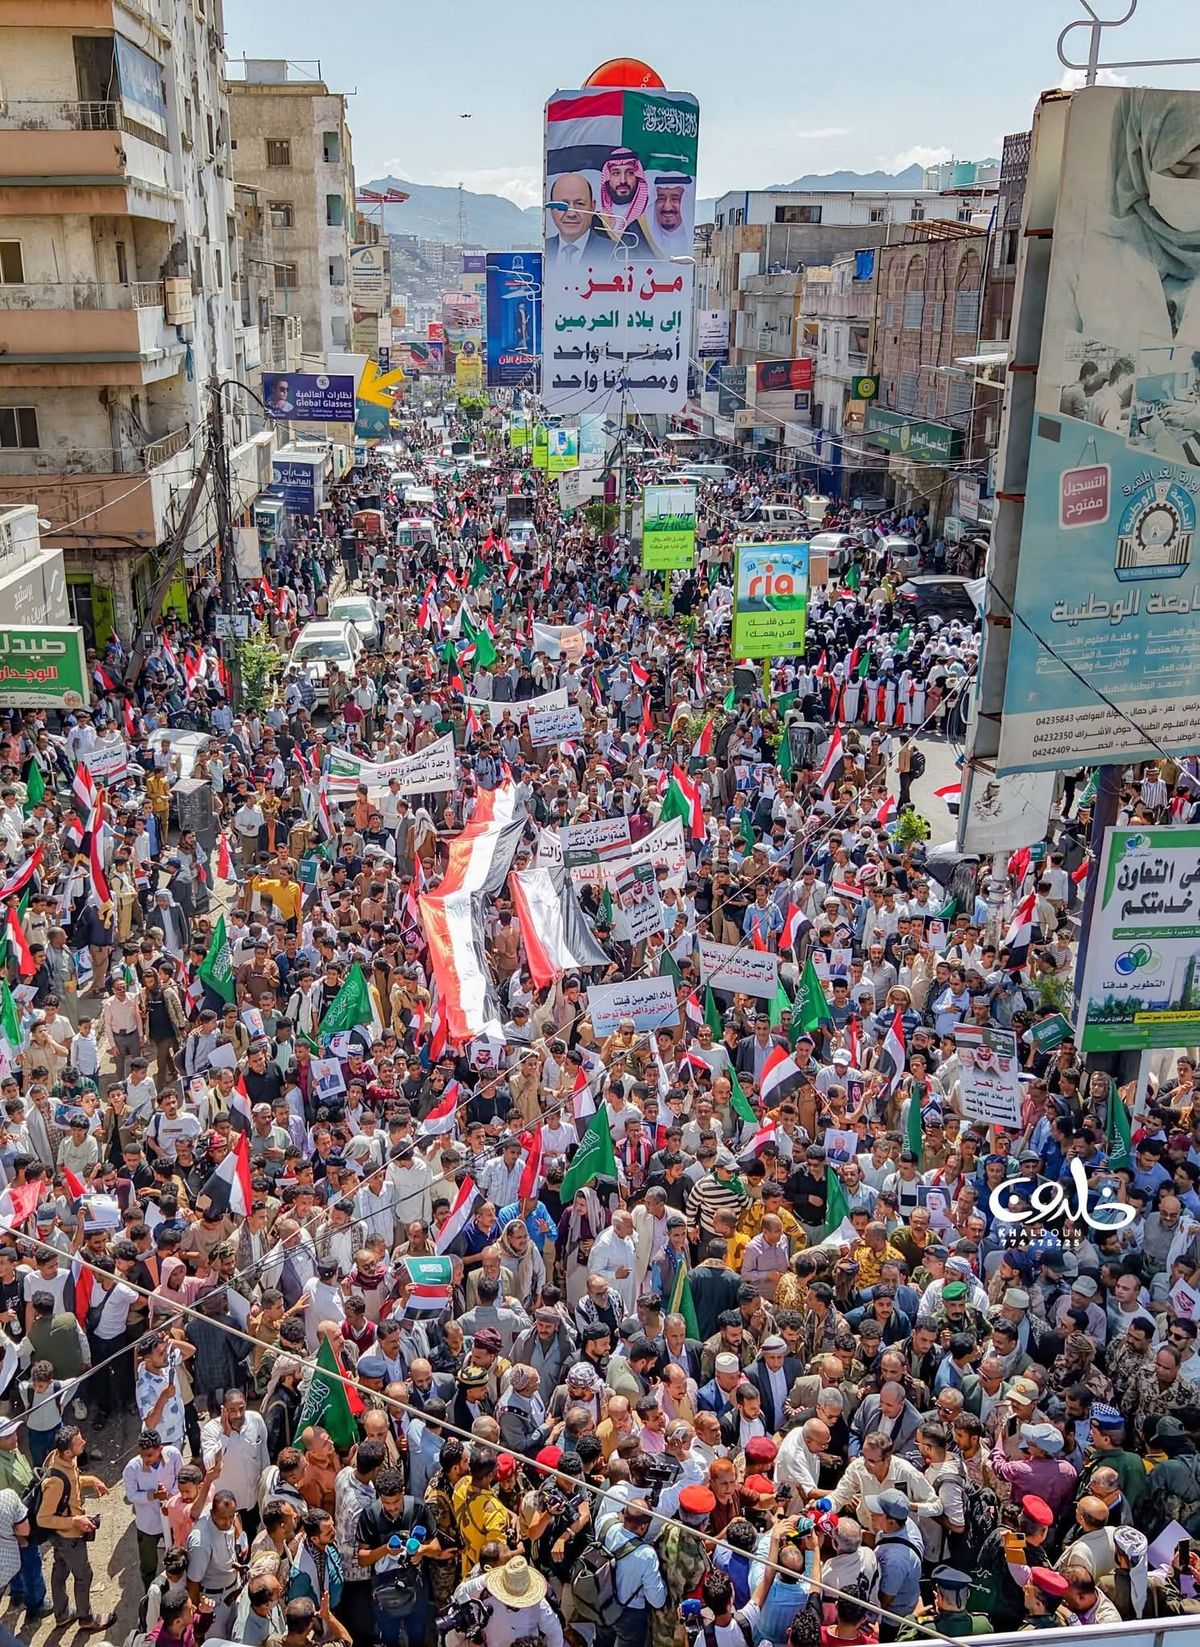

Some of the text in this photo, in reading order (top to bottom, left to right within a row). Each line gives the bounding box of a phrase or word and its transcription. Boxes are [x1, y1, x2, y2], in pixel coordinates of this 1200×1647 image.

[640, 267, 683, 301] من
[554, 310, 619, 333] الحرمين
[626, 310, 654, 332] بلاد
[553, 341, 599, 364] واحد
[552, 369, 598, 393] واحد
[295, 390, 352, 401] نظارات العالمية
[296, 400, 352, 409] Global Glasses
[1063, 474, 1106, 497] التسجيل
[1066, 497, 1103, 519] مفتوح
[748, 564, 794, 598] ria
[1050, 584, 1200, 627] امعة الوطنية
[748, 618, 796, 627] من قلبك
[779, 629, 795, 638] لمن
[0, 633, 67, 661] صيدل
[1182, 702, 1200, 712] رئيس
[1036, 714, 1074, 726] 04235843
[1033, 731, 1073, 743] 04232350
[1032, 745, 1071, 758] 04242409
[1117, 858, 1175, 891] التعاون
[1121, 890, 1193, 921] خدمتكم
[1102, 979, 1166, 991] التطوير هدفنا
[612, 990, 672, 1007] بلاد الحرمين قبلتنا
